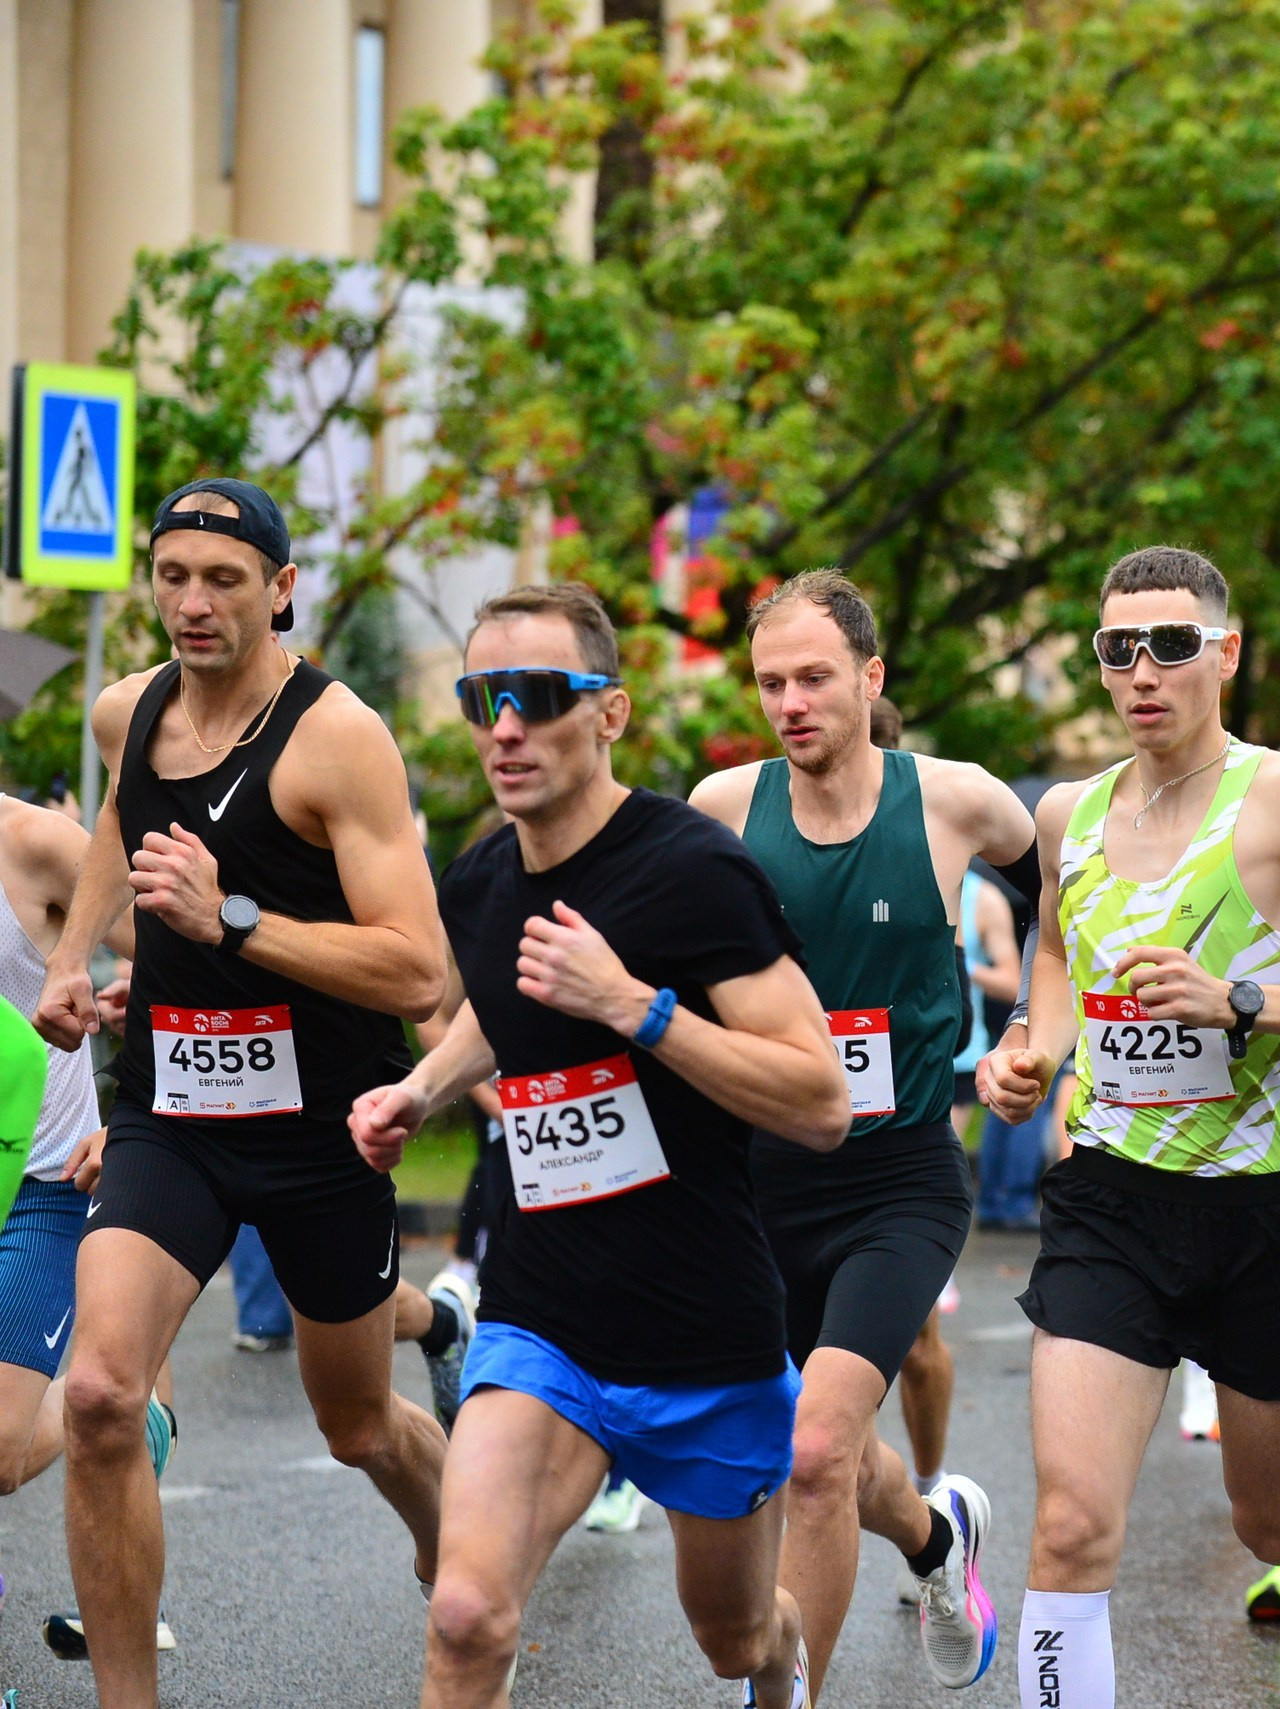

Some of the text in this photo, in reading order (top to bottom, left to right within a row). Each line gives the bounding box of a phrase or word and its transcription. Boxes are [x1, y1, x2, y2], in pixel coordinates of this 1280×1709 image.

[1096, 1000, 1105, 1011] 10
[169, 1013, 179, 1024] 10
[1100, 1024, 1202, 1060] 4225
[169, 1037, 276, 1074] 4558
[1129, 1063, 1175, 1075] ЕВГЕНИЙ
[199, 1076, 244, 1087] ЕВГЕНИЙ
[515, 1097, 625, 1156] 5435
[540, 1150, 604, 1170] АЛЕКСАНДР
[1038, 1655, 1060, 1709] NOR
